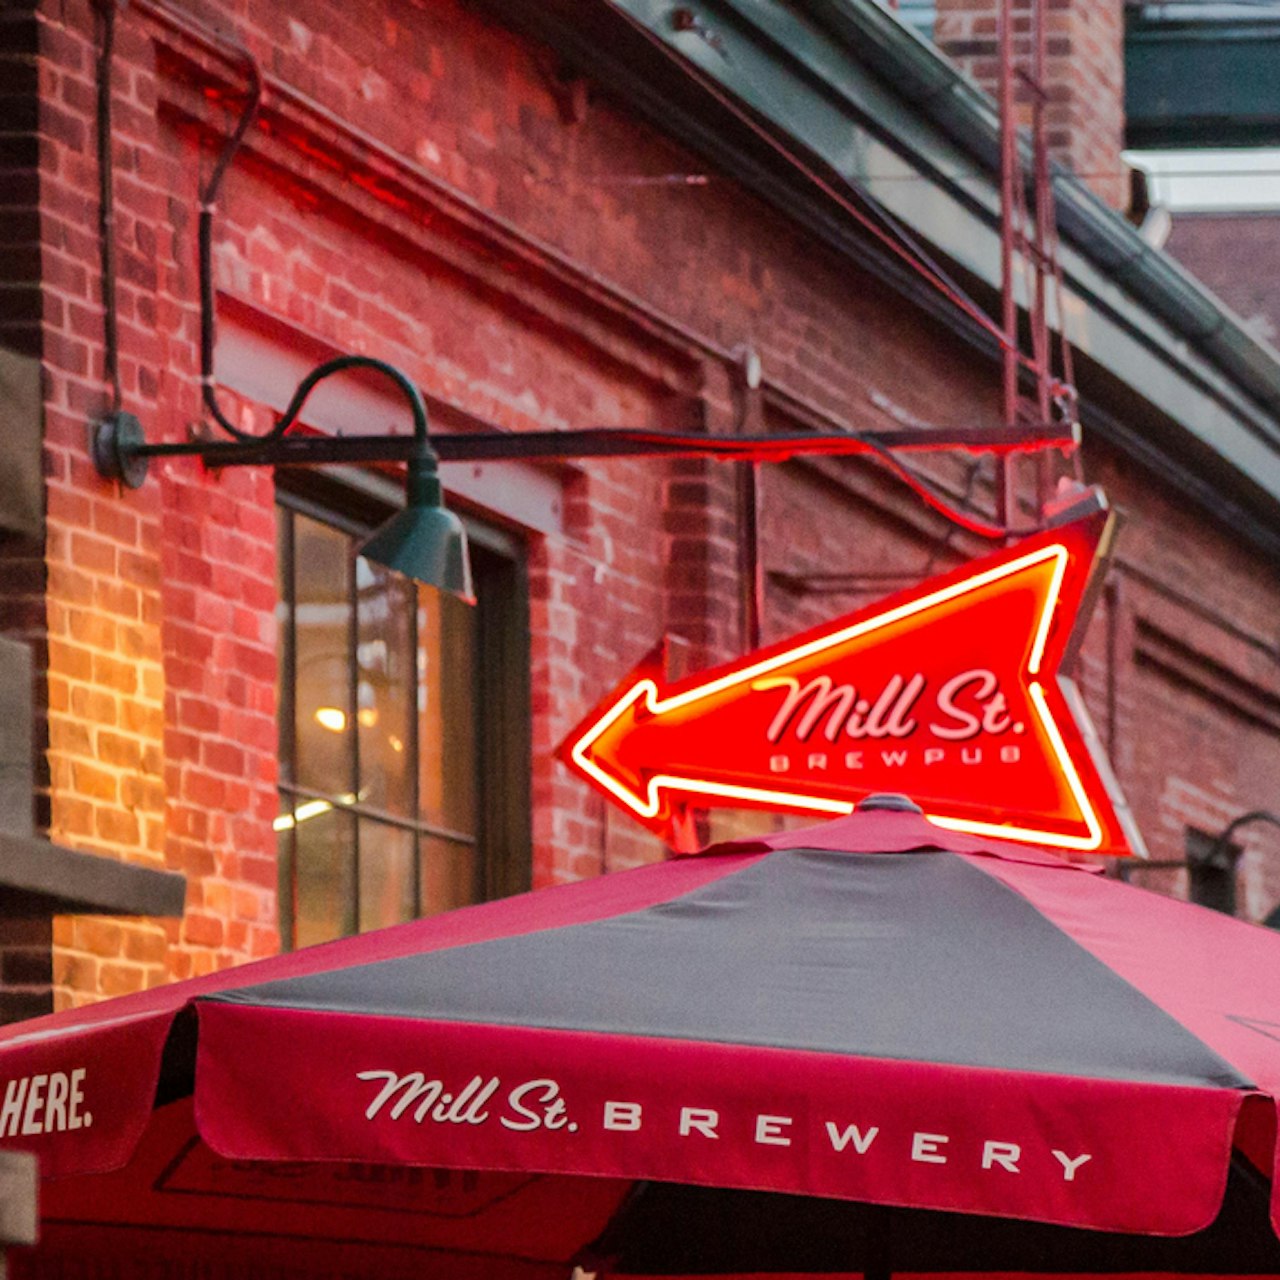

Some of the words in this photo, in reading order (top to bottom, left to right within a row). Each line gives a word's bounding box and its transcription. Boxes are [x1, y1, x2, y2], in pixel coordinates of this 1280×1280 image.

[752, 673, 916, 742] Mill
[930, 669, 1025, 740] St.
[769, 745, 1021, 773] BREWPUB
[0, 1067, 94, 1138] HERE.
[356, 1070, 501, 1124] Mill
[500, 1078, 579, 1132] St.
[603, 1101, 1092, 1181] BREWERY
